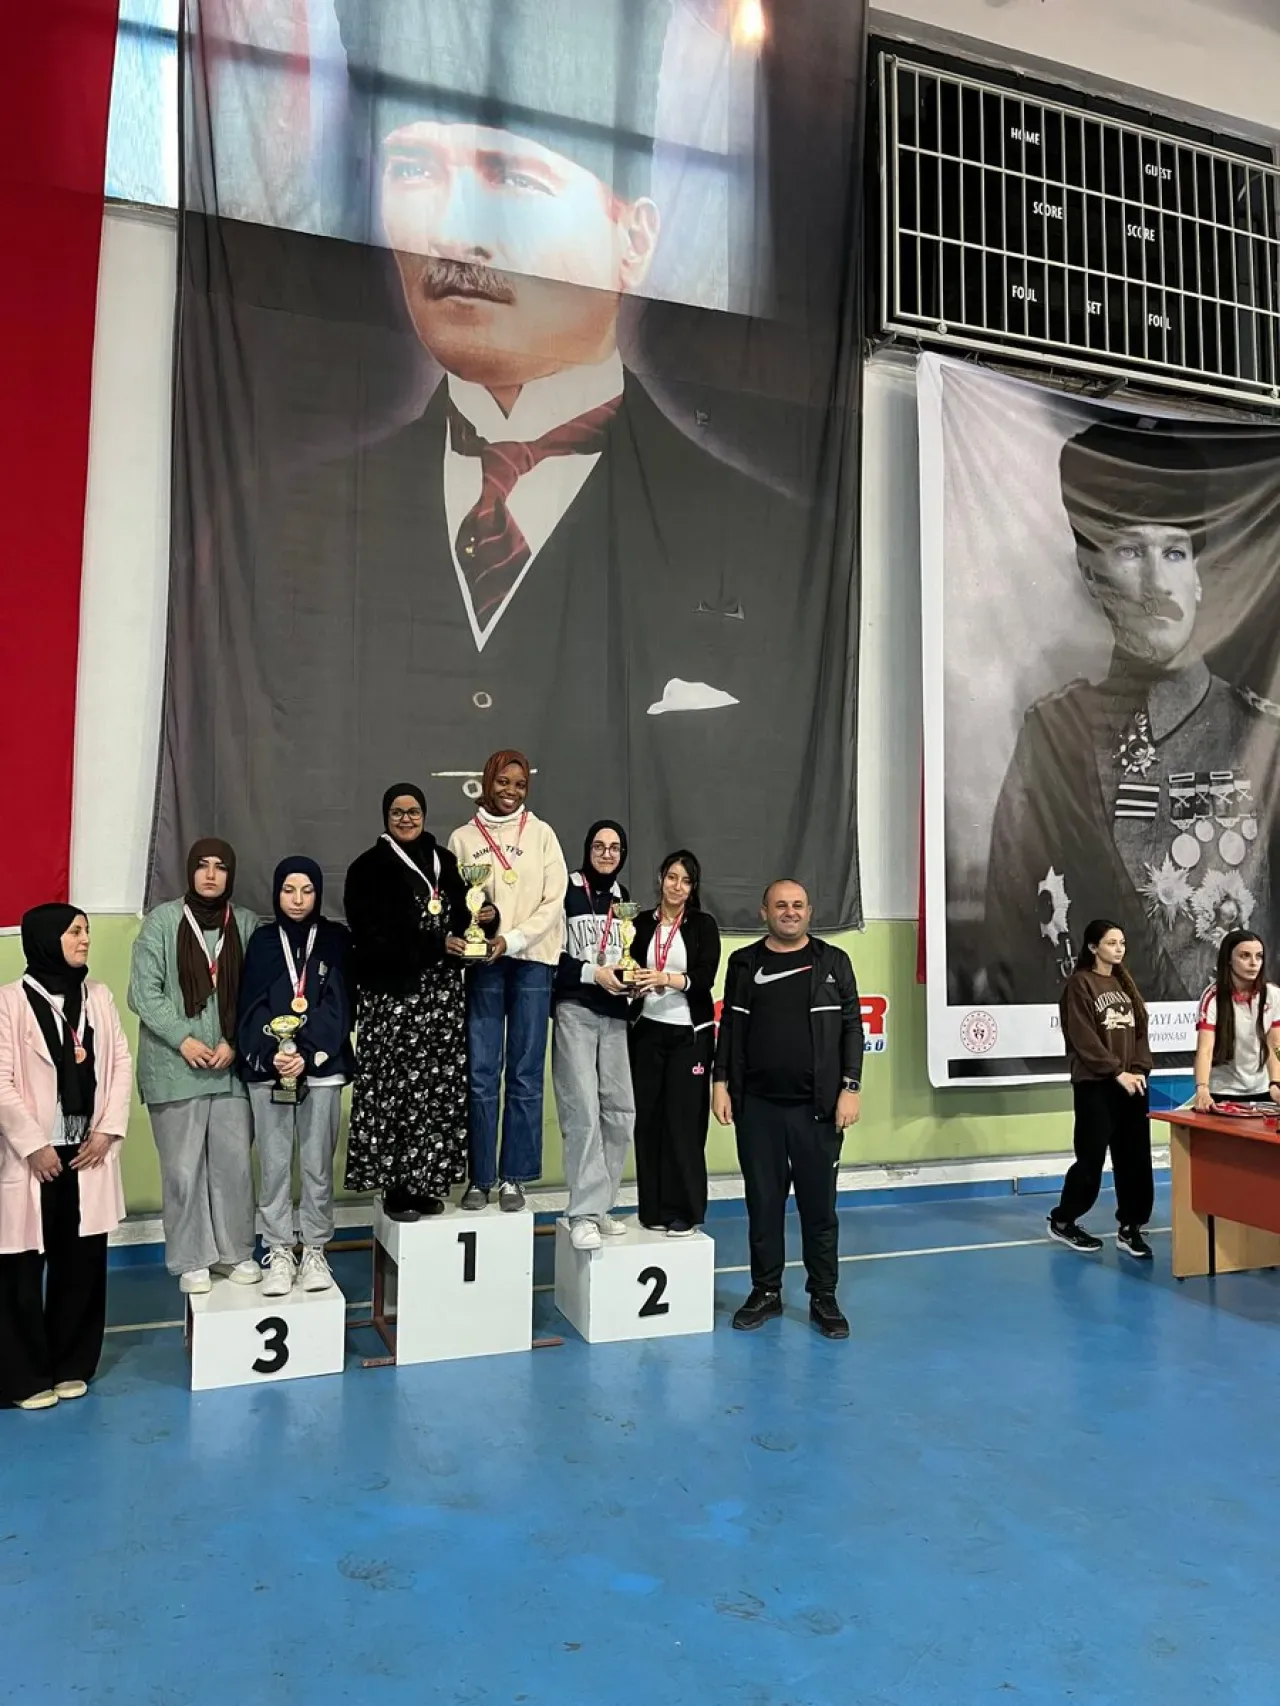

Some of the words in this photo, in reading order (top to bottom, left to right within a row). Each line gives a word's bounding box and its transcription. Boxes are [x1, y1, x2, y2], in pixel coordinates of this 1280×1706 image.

[1010, 127, 1040, 146] HOME
[1033, 201, 1064, 220] SCORE
[1011, 285, 1037, 302] FOUL
[1086, 300, 1102, 315] SET
[1149, 1013, 1172, 1026] AYI
[457, 1231, 477, 1282] 1
[637, 1266, 669, 1317] 2
[252, 1316, 290, 1374] 3
